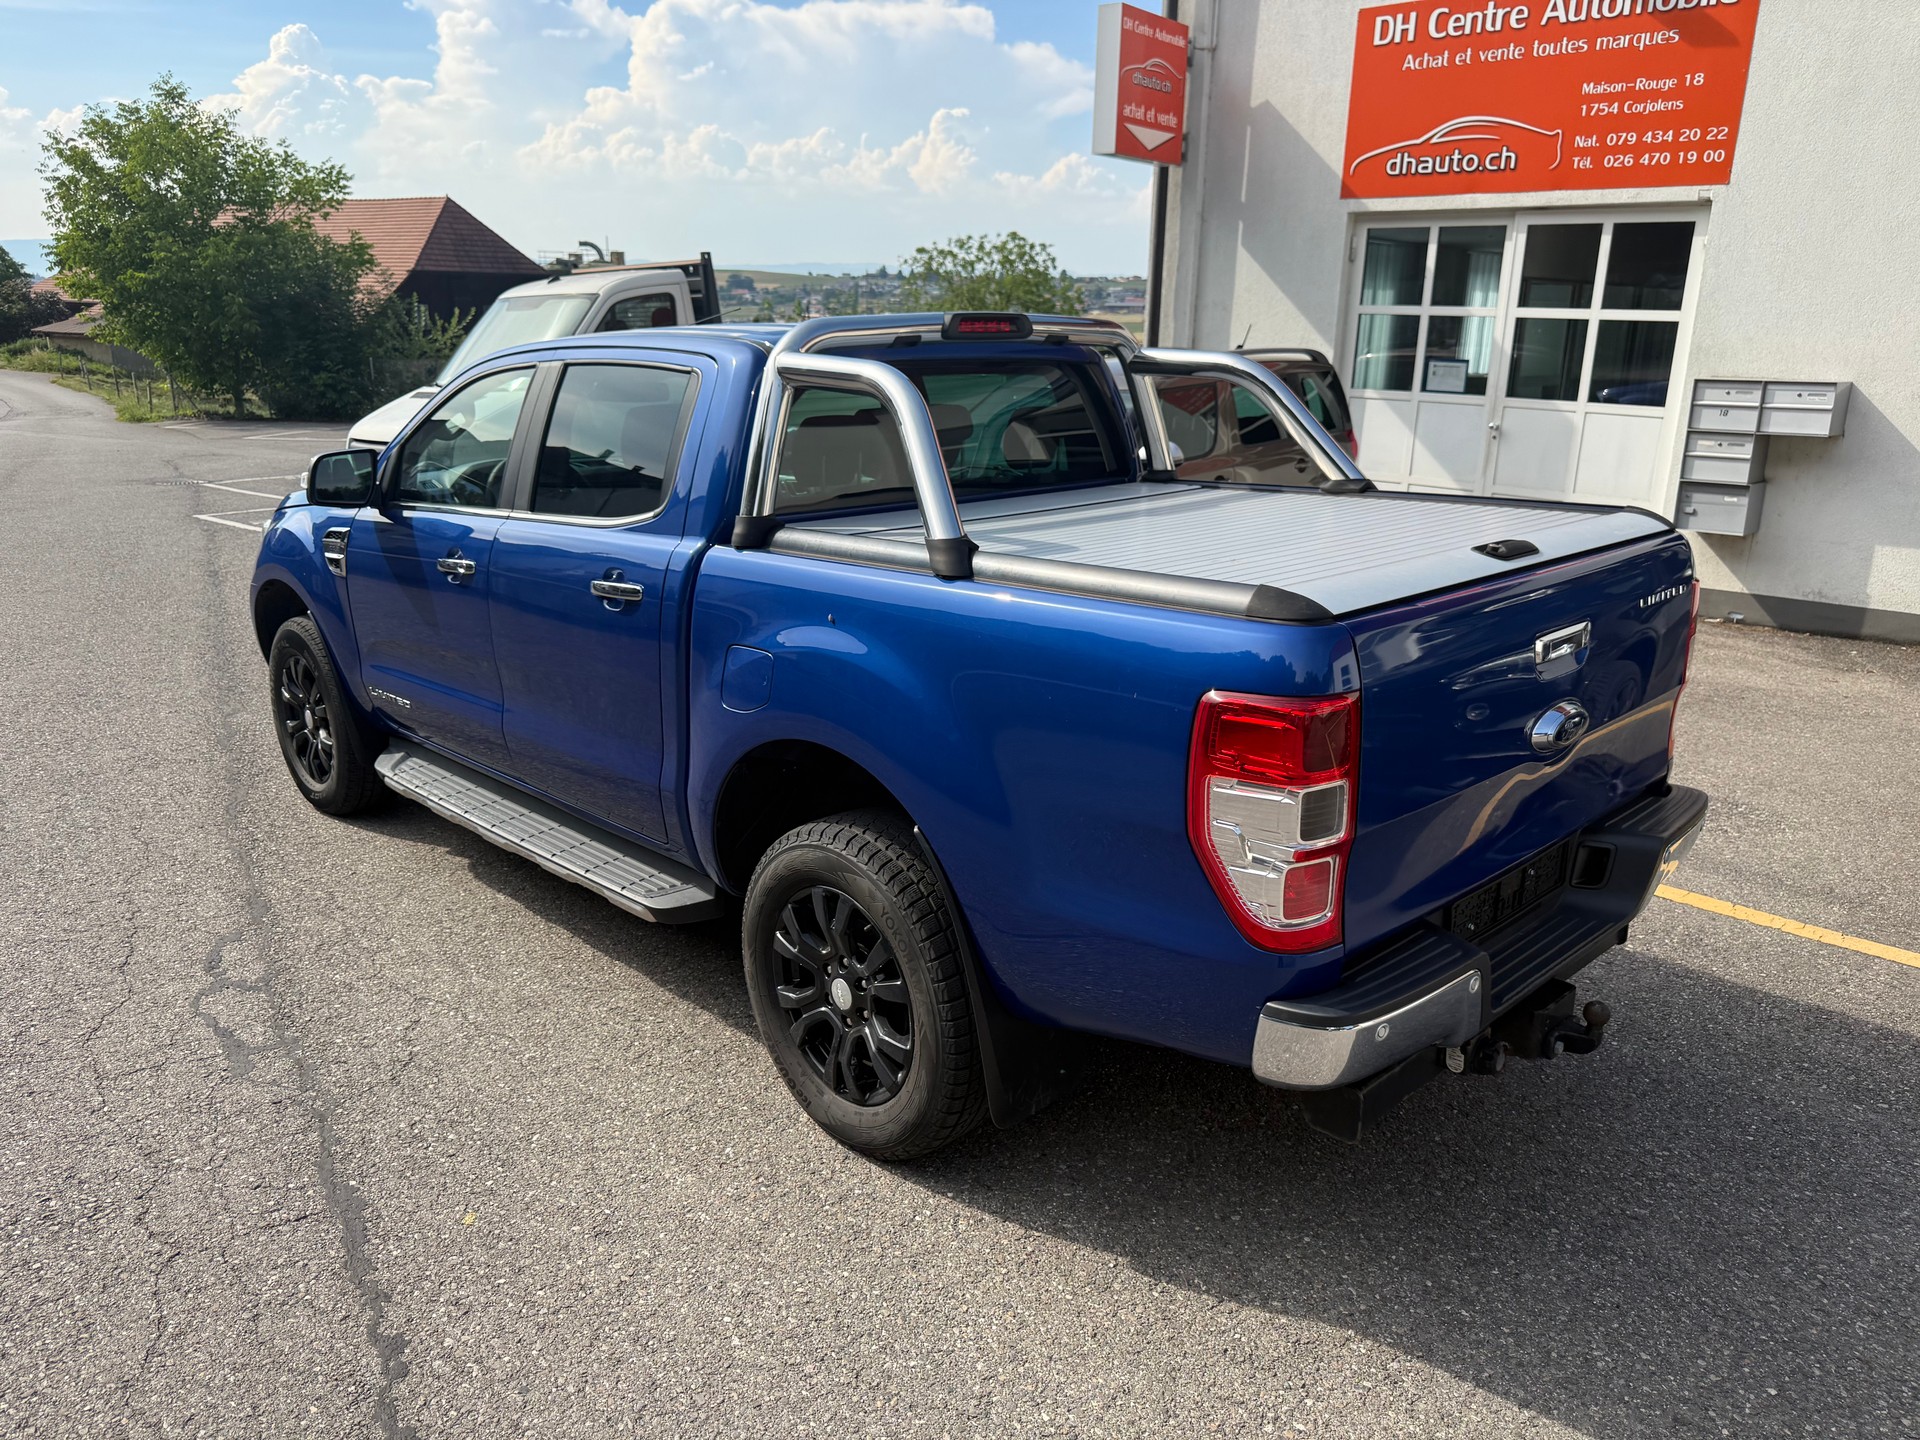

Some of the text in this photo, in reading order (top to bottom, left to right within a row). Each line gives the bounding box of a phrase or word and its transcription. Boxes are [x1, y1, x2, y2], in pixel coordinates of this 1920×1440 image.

[1123, 17, 1186, 48] DH Centre Automobile
[1373, 11, 1417, 46] DH
[1428, 1, 1529, 38] Centre
[1402, 29, 1680, 71] Achat et vente toutes marques
[1581, 72, 1705, 95] Maison-Rouge 18
[1122, 102, 1178, 128] achat et vente
[1580, 98, 1684, 117] 1754 Corjolens
[1574, 126, 1729, 148] Nat. 079 434 20 22
[1386, 146, 1517, 176] dhauto.ch
[1572, 149, 1726, 169] Tél. 026 470 19 00
[1640, 584, 1687, 608] LIMITED
